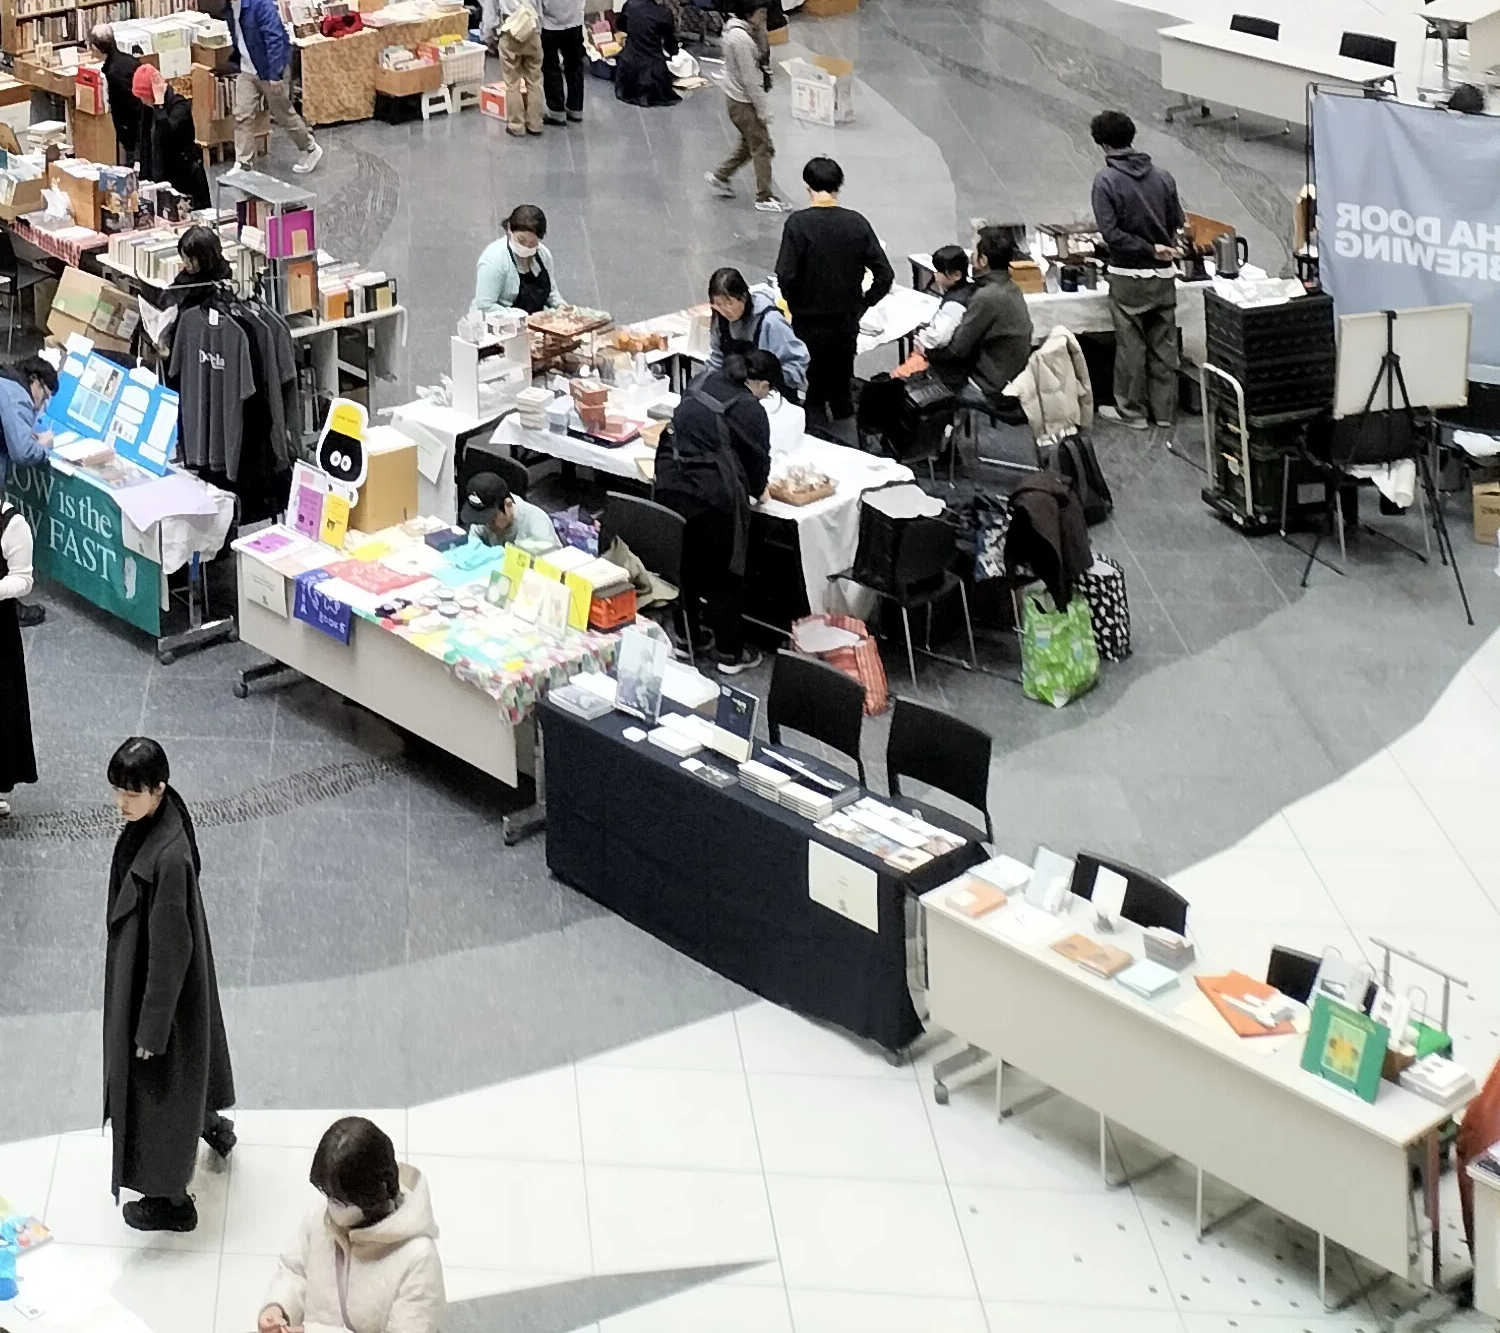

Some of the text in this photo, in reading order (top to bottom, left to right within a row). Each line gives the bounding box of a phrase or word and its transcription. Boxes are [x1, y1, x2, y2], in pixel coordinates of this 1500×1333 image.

[58, 481, 76, 519] is
[78, 496, 113, 539] the
[49, 516, 117, 581] FAST
